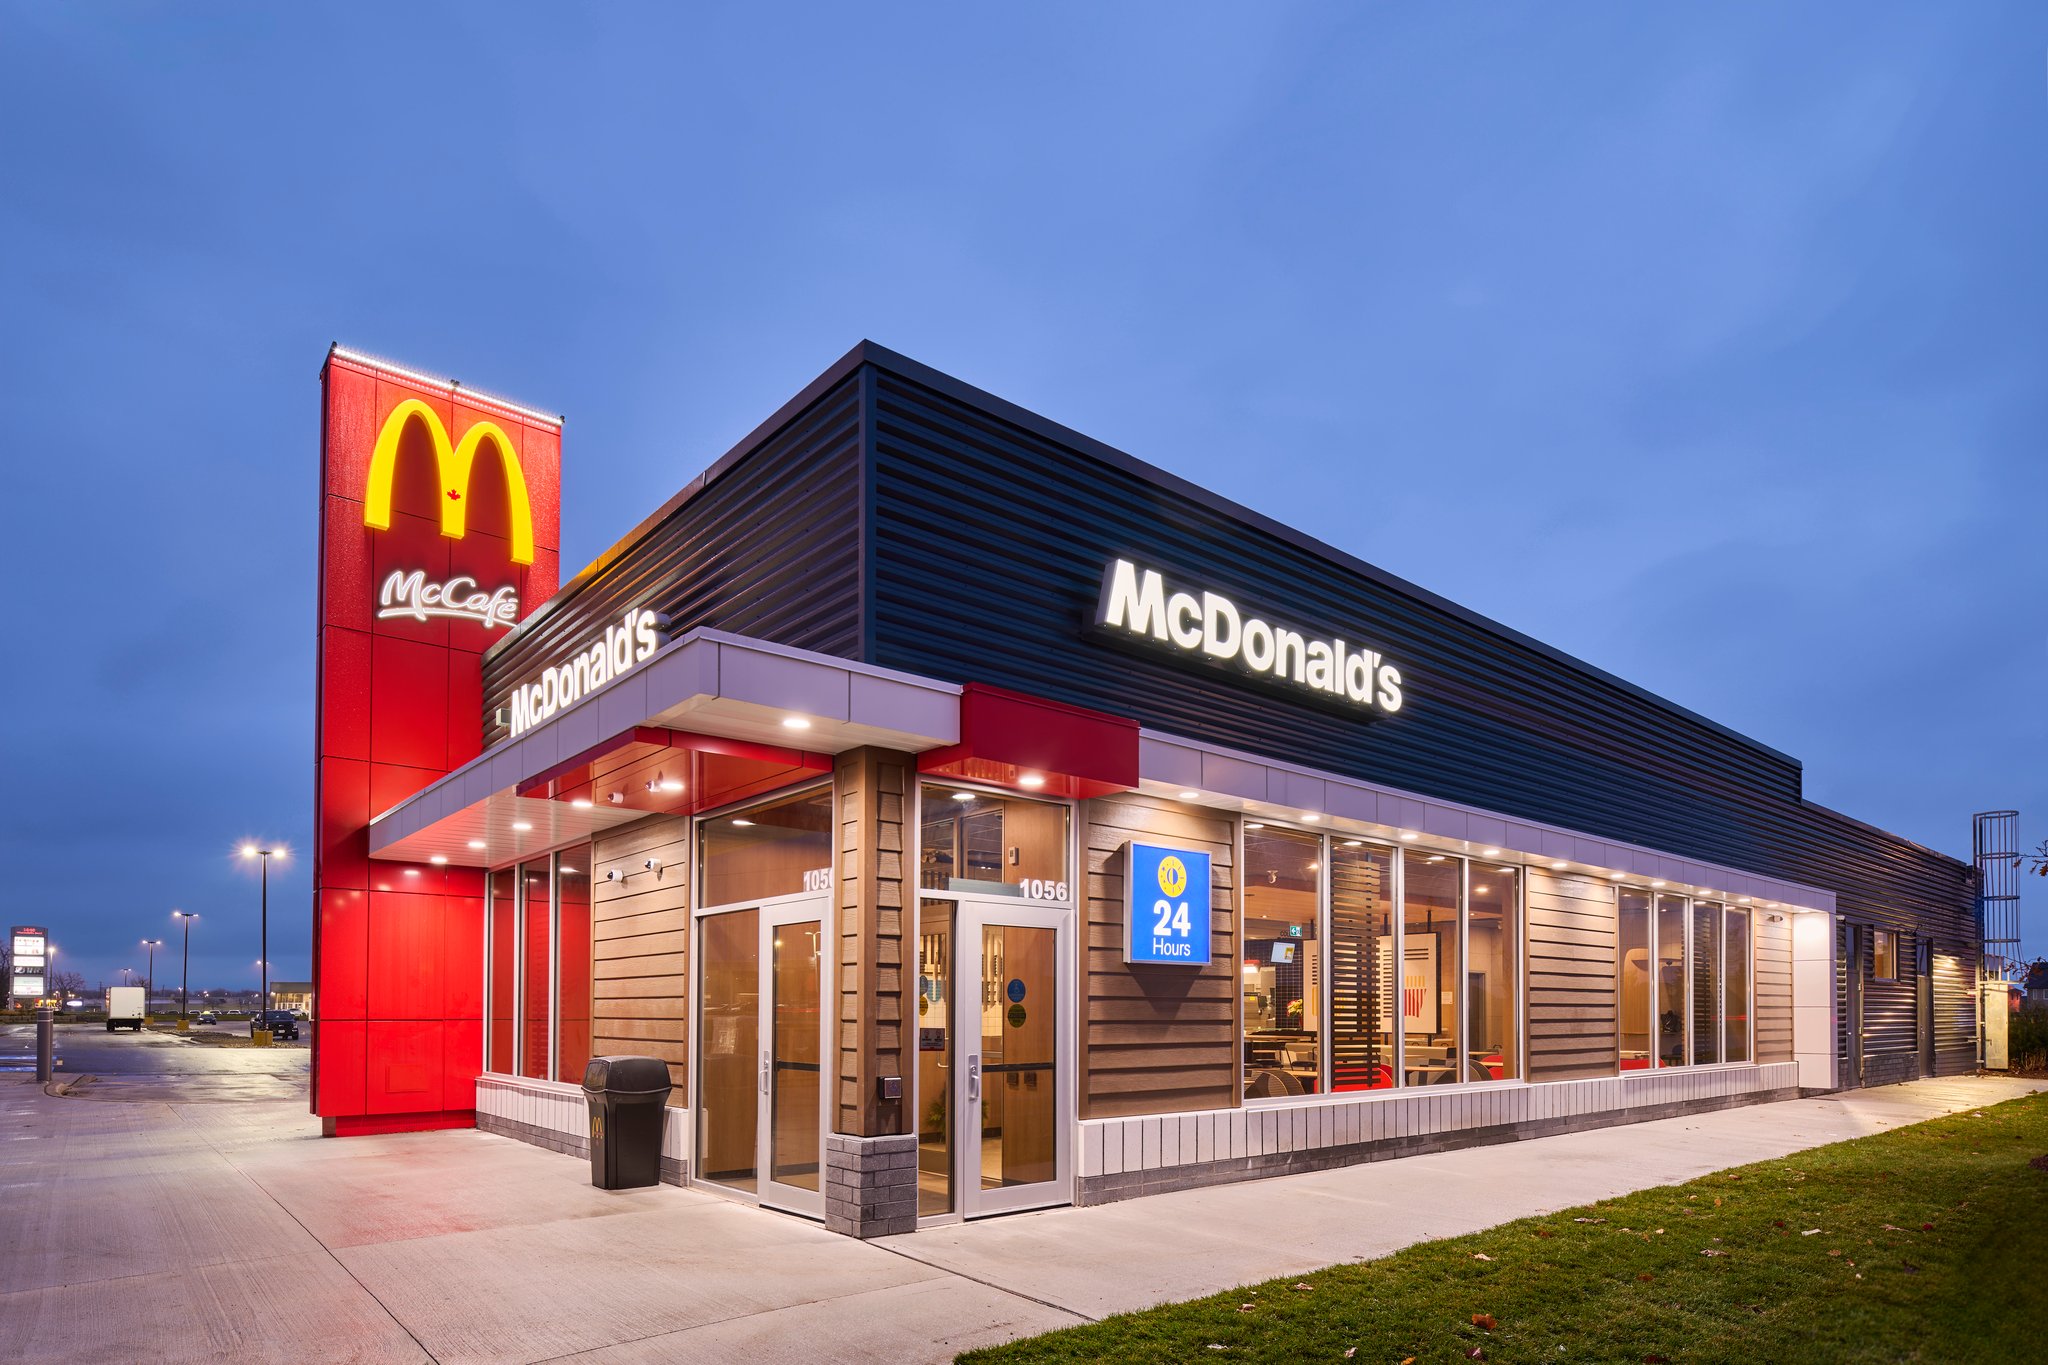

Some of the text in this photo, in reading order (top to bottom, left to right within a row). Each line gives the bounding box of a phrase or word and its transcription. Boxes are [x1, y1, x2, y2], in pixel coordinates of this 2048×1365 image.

[378, 570, 518, 628] McCafé
[1100, 558, 1403, 713] McDonald's
[510, 607, 659, 738] McDonald's
[1019, 878, 1068, 901] 1056
[1153, 899, 1191, 937] 24
[1152, 937, 1191, 957] Hours
